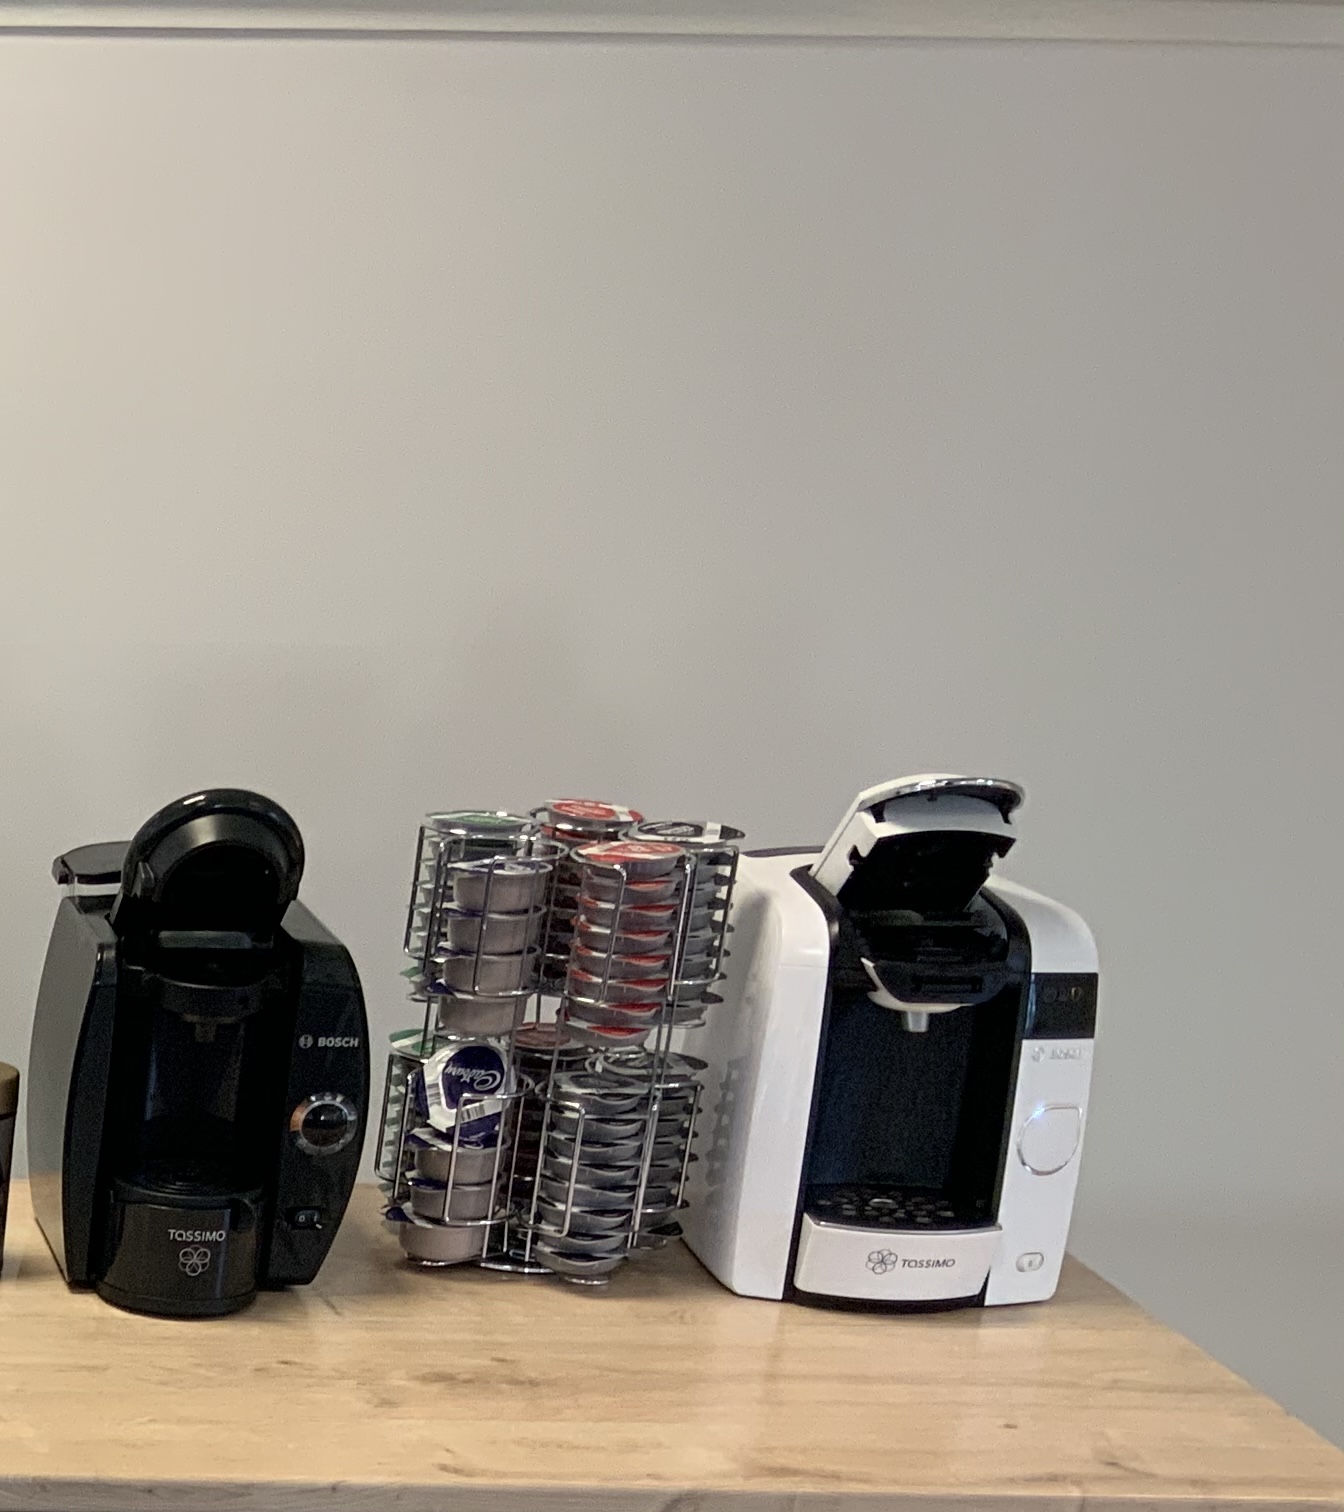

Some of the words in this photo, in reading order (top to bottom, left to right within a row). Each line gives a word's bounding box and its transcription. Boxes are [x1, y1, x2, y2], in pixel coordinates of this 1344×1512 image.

[318, 1036, 359, 1047] BOSCH
[444, 1065, 501, 1091] Cadbury
[167, 1228, 226, 1241] TASSIMO
[901, 1258, 956, 1268] TASSIMO
